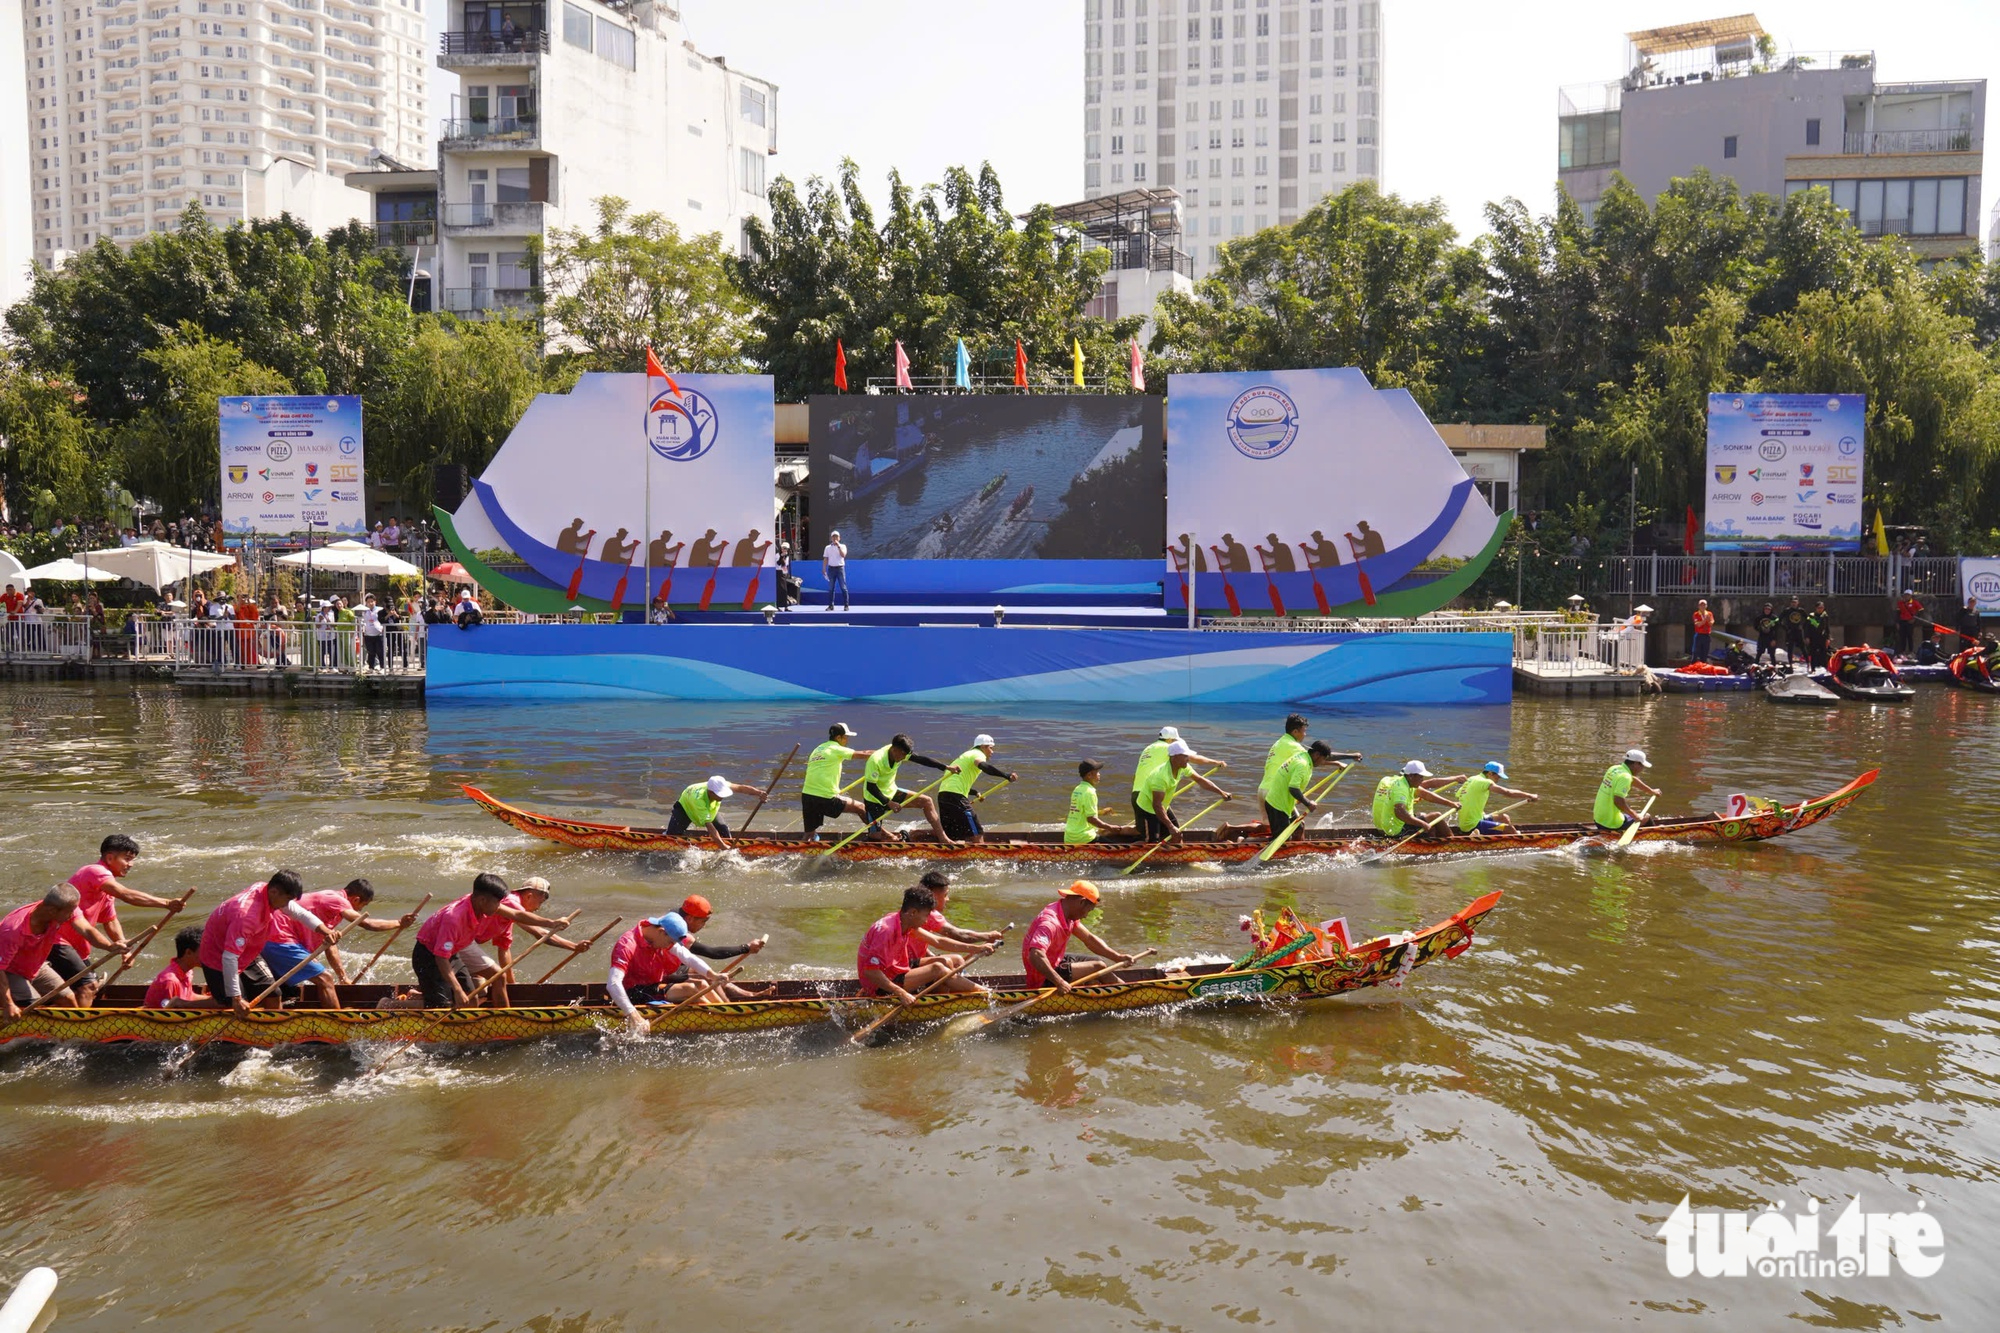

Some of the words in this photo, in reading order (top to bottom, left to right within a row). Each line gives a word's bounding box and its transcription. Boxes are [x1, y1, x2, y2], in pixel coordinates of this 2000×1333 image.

[270, 447, 288, 455] PIZZA
[1763, 446, 1781, 455] PIZZA
[330, 465, 358, 478] STC
[1827, 466, 1857, 479] STC
[1328, 920, 1349, 951] 1
